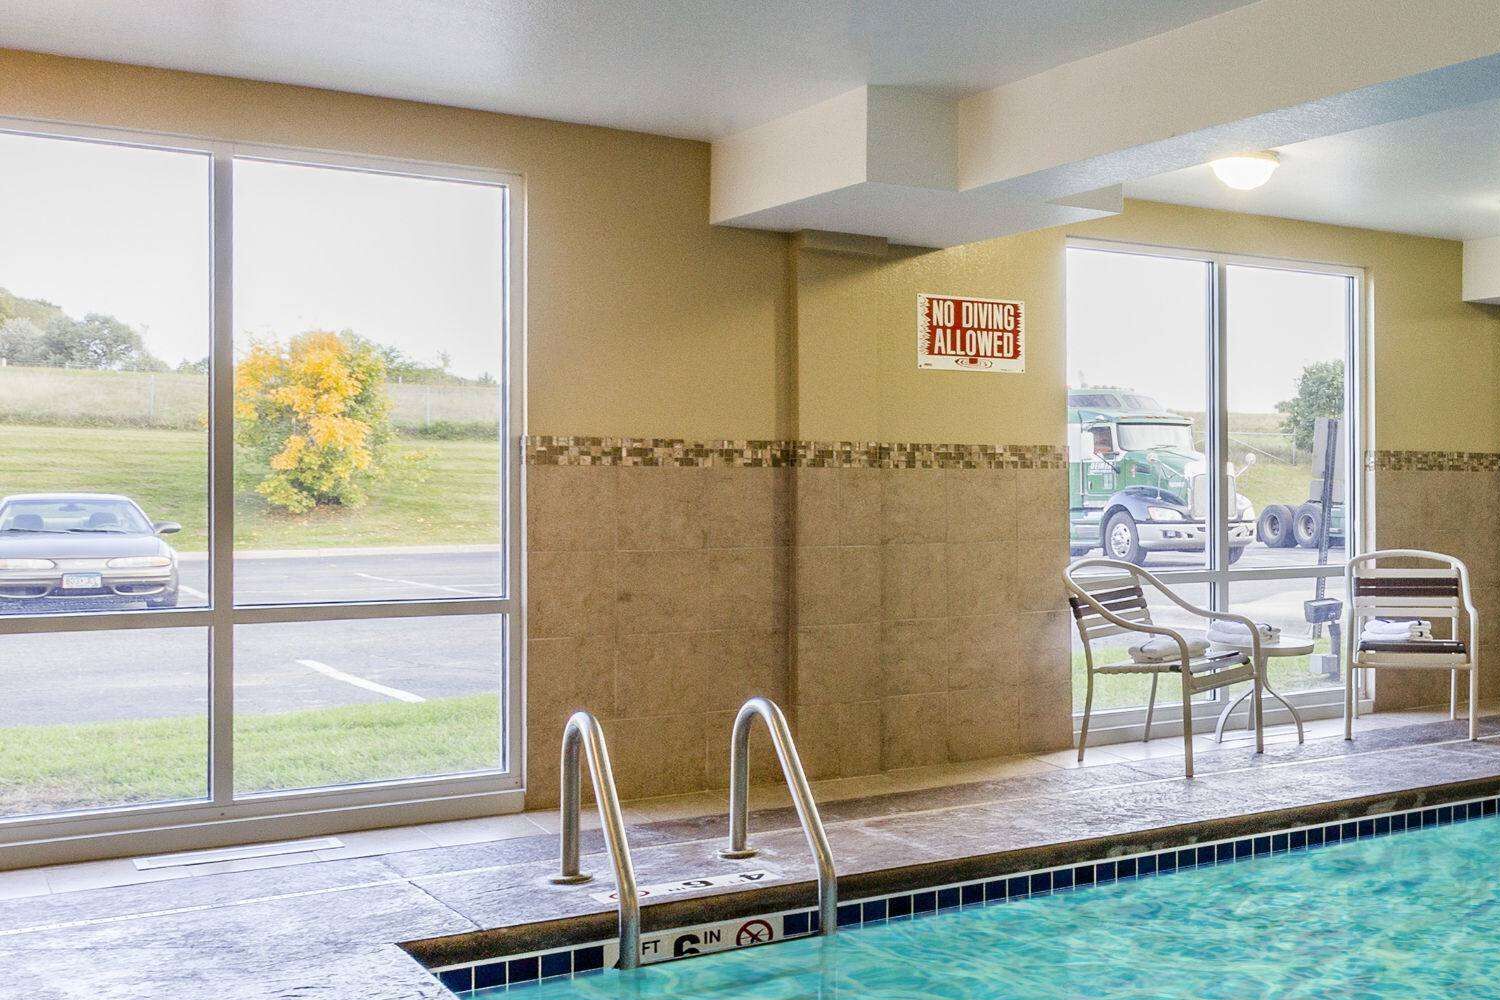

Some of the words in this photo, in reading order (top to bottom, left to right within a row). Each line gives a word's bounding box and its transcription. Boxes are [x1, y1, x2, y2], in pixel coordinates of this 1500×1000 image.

[932, 299, 955, 326] NO
[962, 301, 1015, 331] DIVING
[934, 328, 1014, 358] ALLOWED
[642, 940, 661, 955] FT
[673, 933, 701, 957] 6
[703, 929, 721, 944] IN
